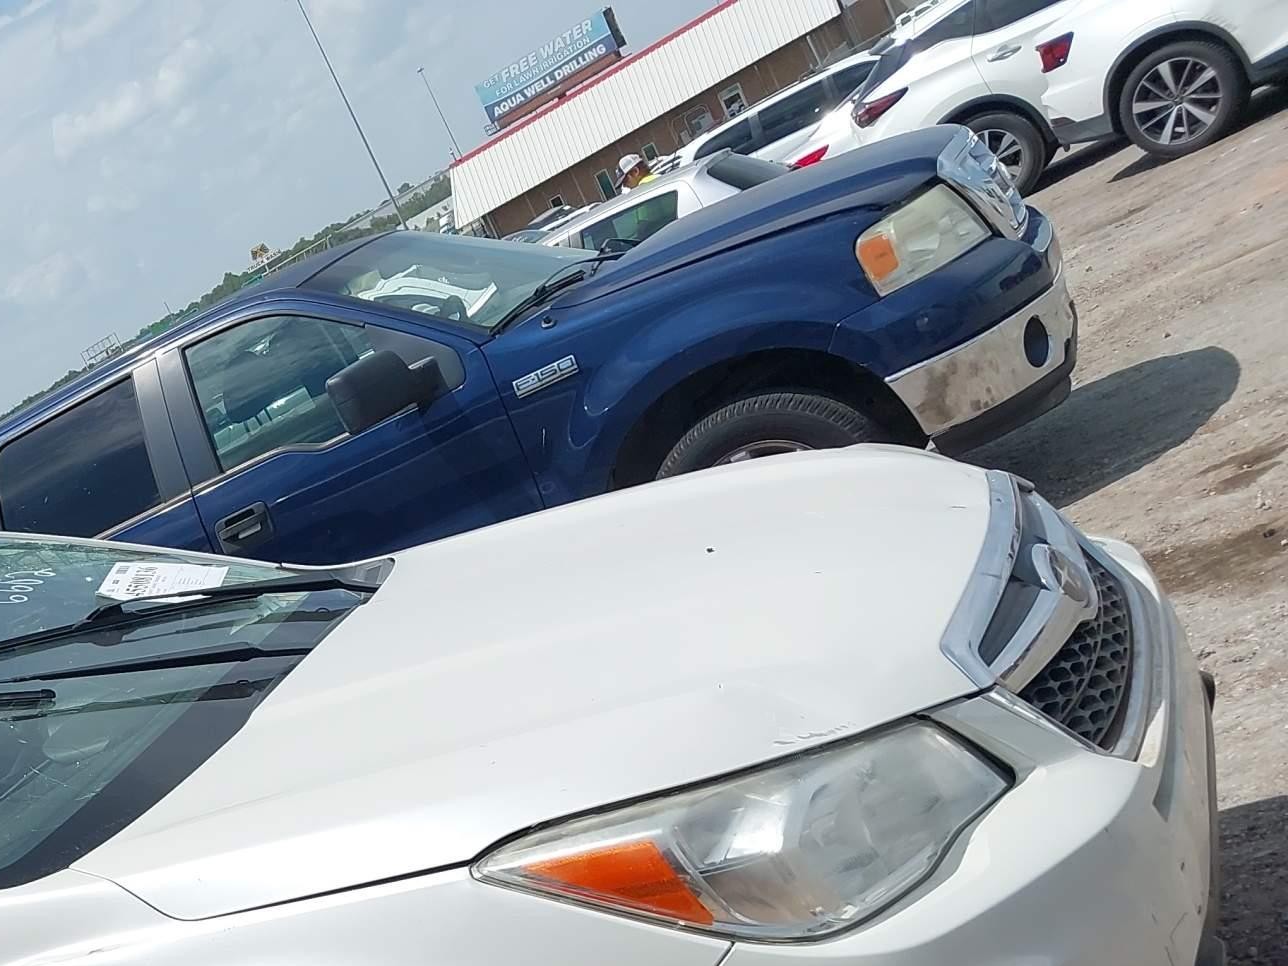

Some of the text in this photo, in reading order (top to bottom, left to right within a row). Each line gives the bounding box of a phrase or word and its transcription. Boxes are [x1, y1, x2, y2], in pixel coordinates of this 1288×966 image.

[483, 19, 594, 89] GET FREE WATER
[493, 43, 607, 117] AQUA WELL DRILLING
[495, 37, 590, 97] FOR LAWN IRRIGATION
